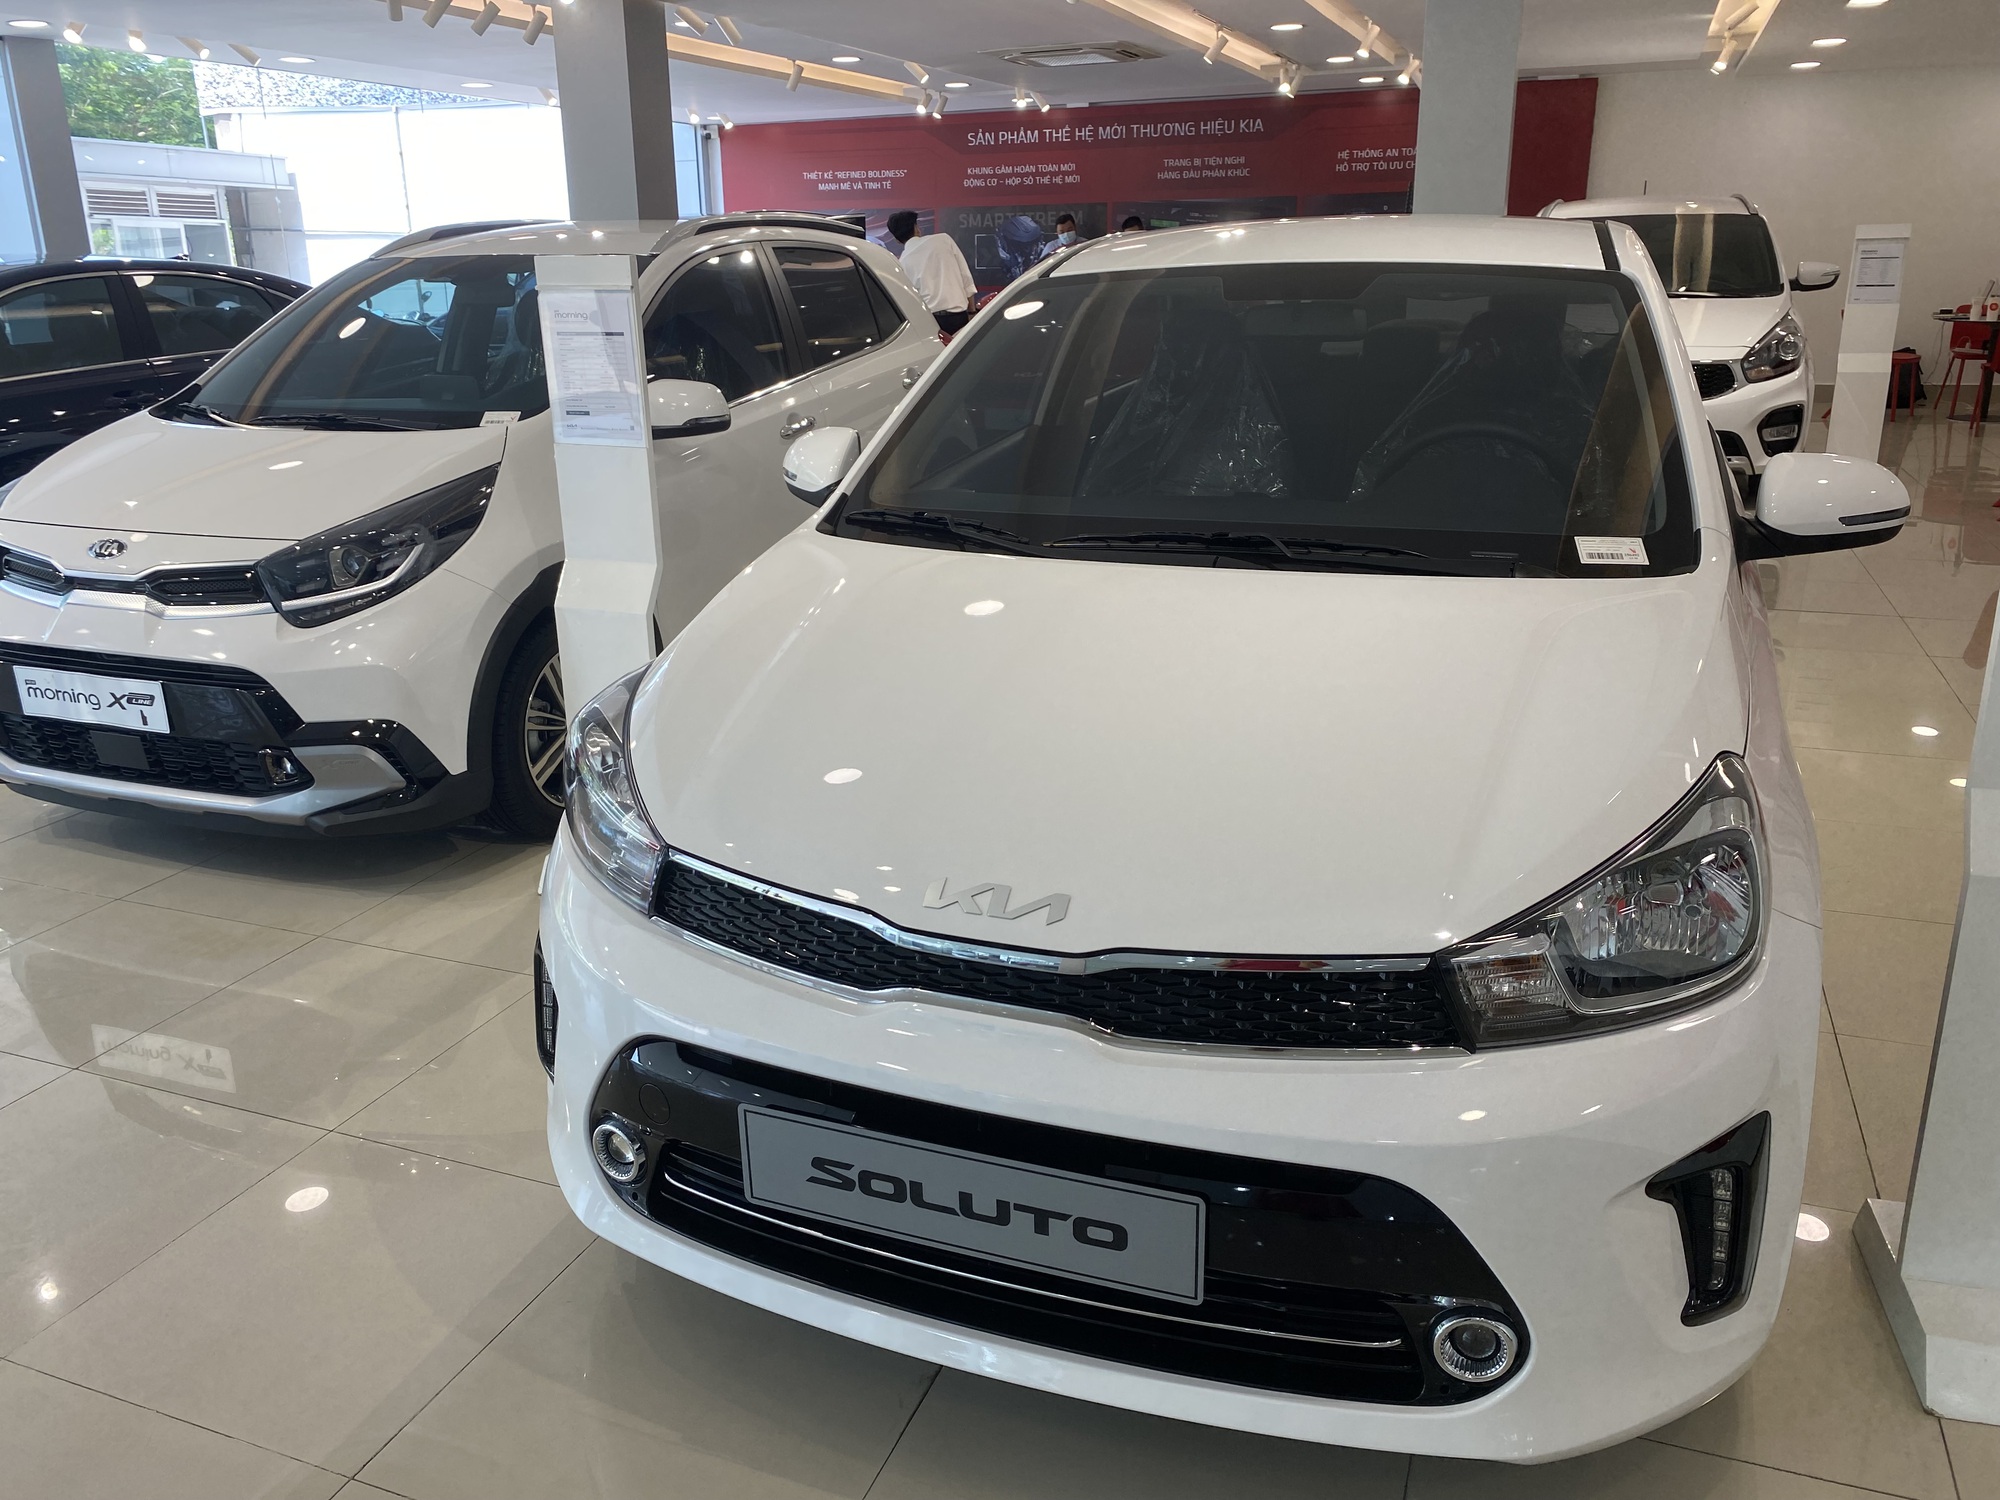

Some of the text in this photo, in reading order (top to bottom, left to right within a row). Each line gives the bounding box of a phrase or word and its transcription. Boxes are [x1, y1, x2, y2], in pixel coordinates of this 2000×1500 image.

[967, 117, 1264, 146] SẢN PHẨM THẾ HỆ MỚI THƯƠNG HIỆU KIA
[1385, 148, 1399, 157] AN
[1163, 158, 1192, 167] TRANG
[1224, 155, 1246, 164] NGHI
[967, 166, 994, 175] KHUNG
[1060, 162, 1076, 171] MỚI
[1064, 174, 1081, 183] MỚI
[864, 181, 881, 189] TINH
[554, 311, 588, 320] morning
[27, 686, 101, 711] morning
[131, 697, 153, 706] LINE
[805, 1156, 1128, 1252] SOLUTO
